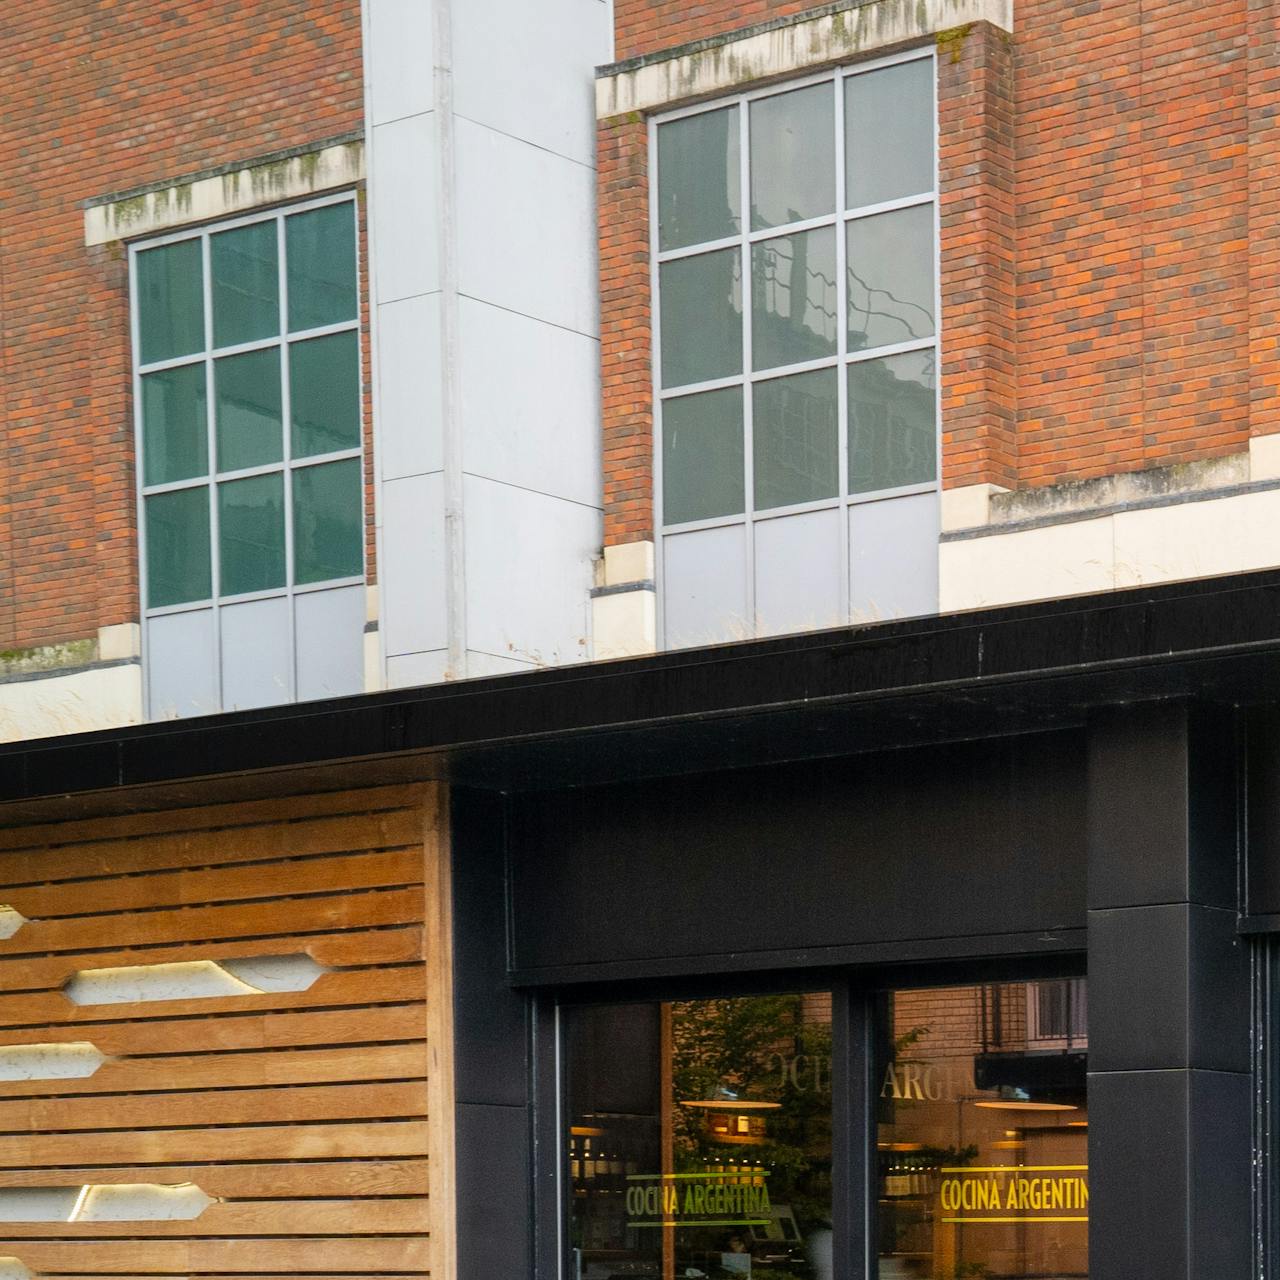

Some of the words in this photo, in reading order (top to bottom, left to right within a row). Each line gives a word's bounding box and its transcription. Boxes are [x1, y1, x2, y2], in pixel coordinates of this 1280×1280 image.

[625, 1186, 680, 1217] COCINA
[684, 1183, 771, 1216] ARGENTINA
[940, 1179, 1002, 1212] COCINA
